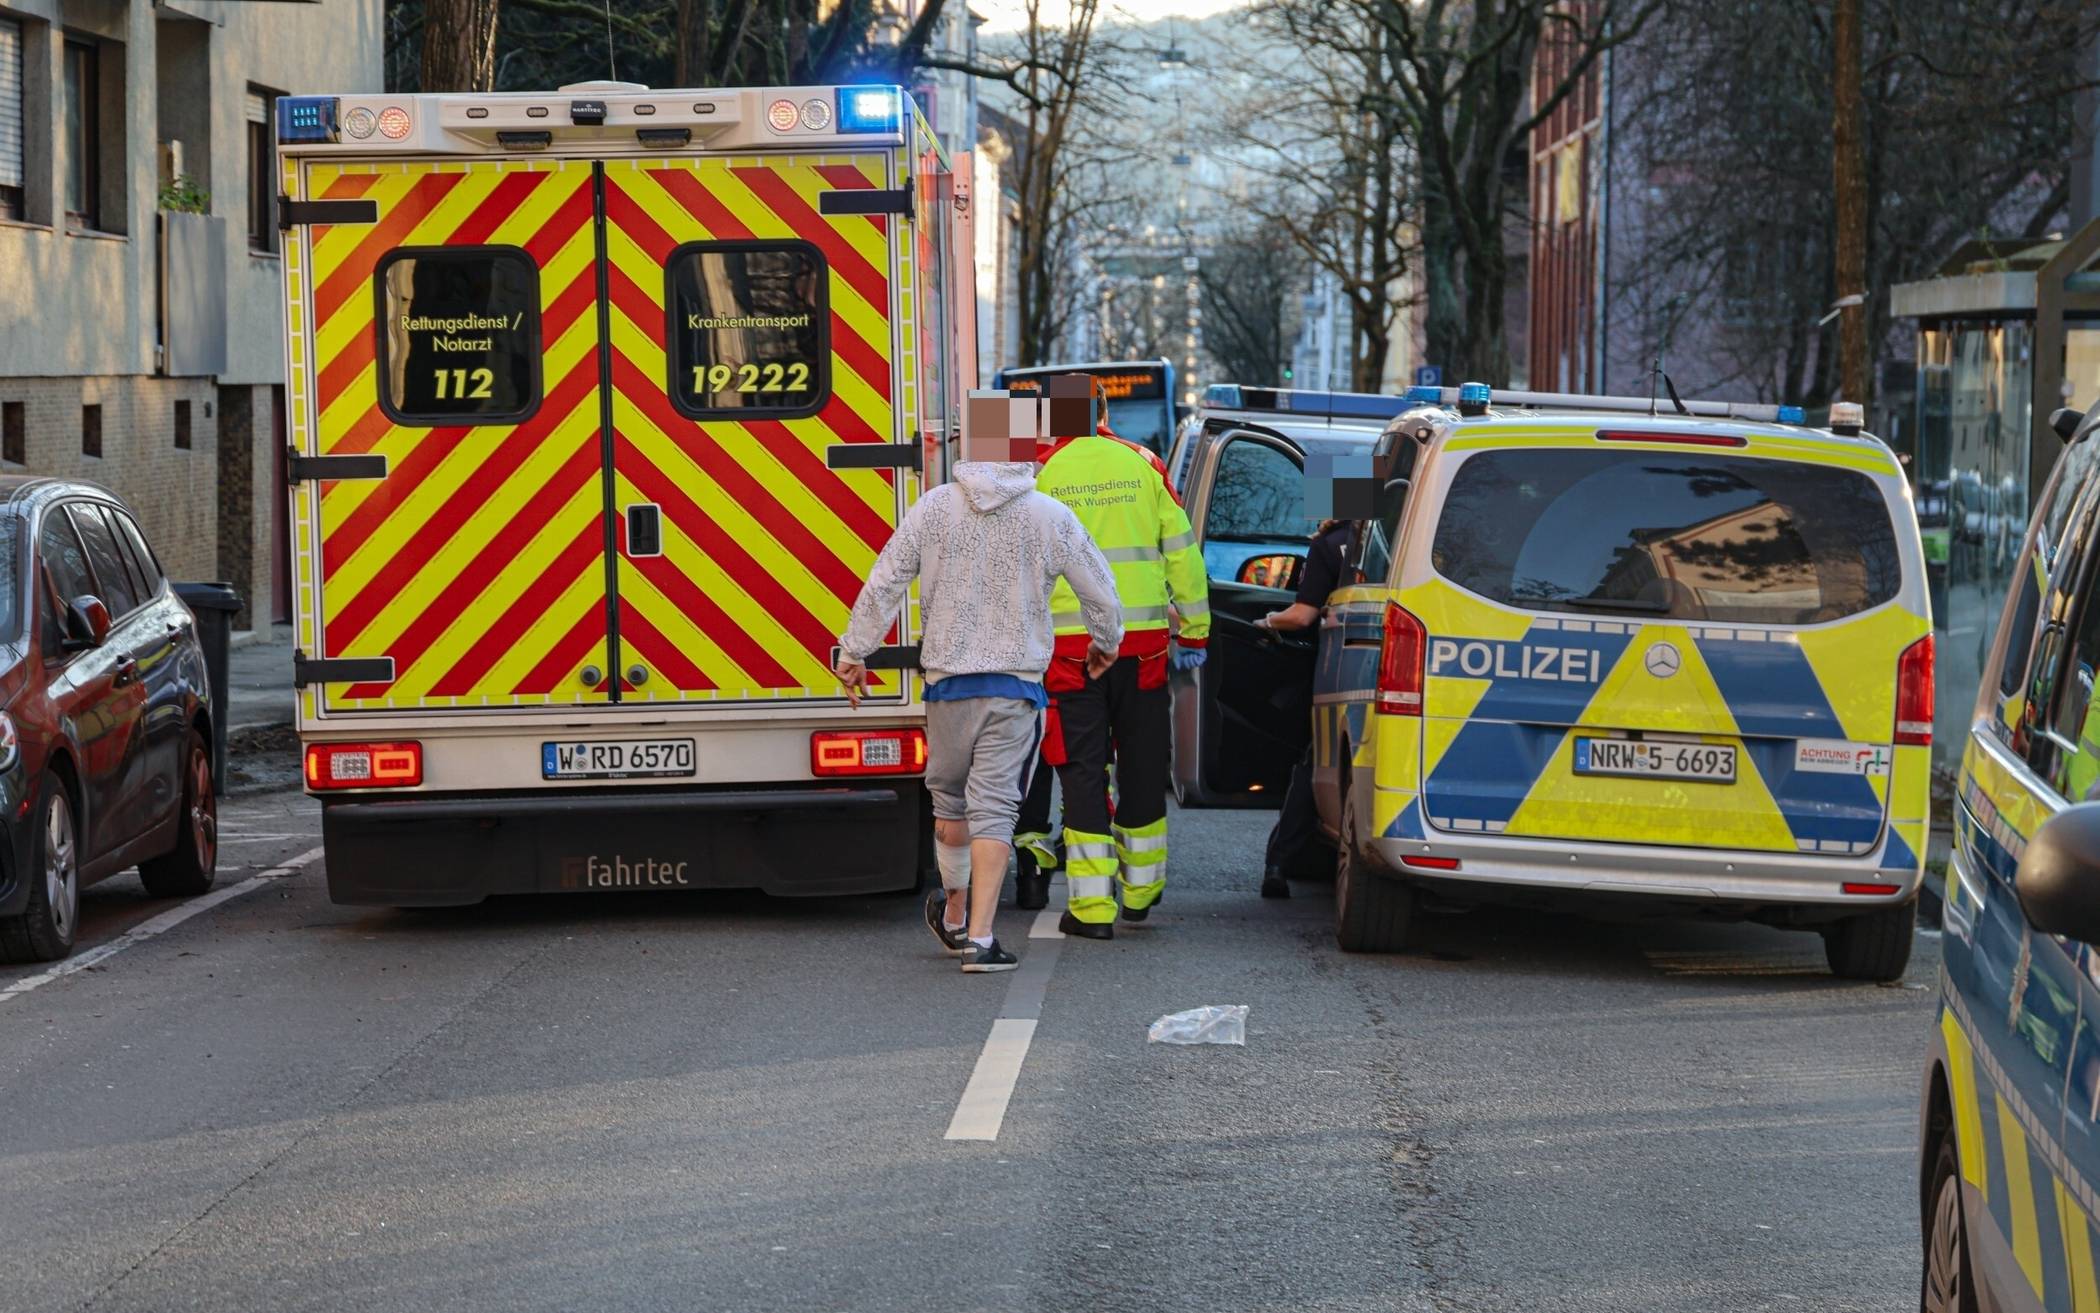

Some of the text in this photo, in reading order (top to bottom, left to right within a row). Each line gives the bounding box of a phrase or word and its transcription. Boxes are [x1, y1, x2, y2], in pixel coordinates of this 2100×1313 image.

[401, 312, 523, 334] Rettungsdienst /
[688, 313, 809, 331] Krankentransport
[432, 336, 493, 352] Notarzt
[434, 367, 494, 399] 112
[1050, 479, 1142, 497] Rettungsdienst
[1085, 494, 1137, 508] Wuppertal
[1431, 640, 1600, 683] POLIZEI
[559, 744, 690, 770] W RD 6570
[1591, 743, 1733, 775] NRW 5-6693
[1800, 748, 1851, 760] ACHTUNG
[587, 855, 689, 887] fahrtec
